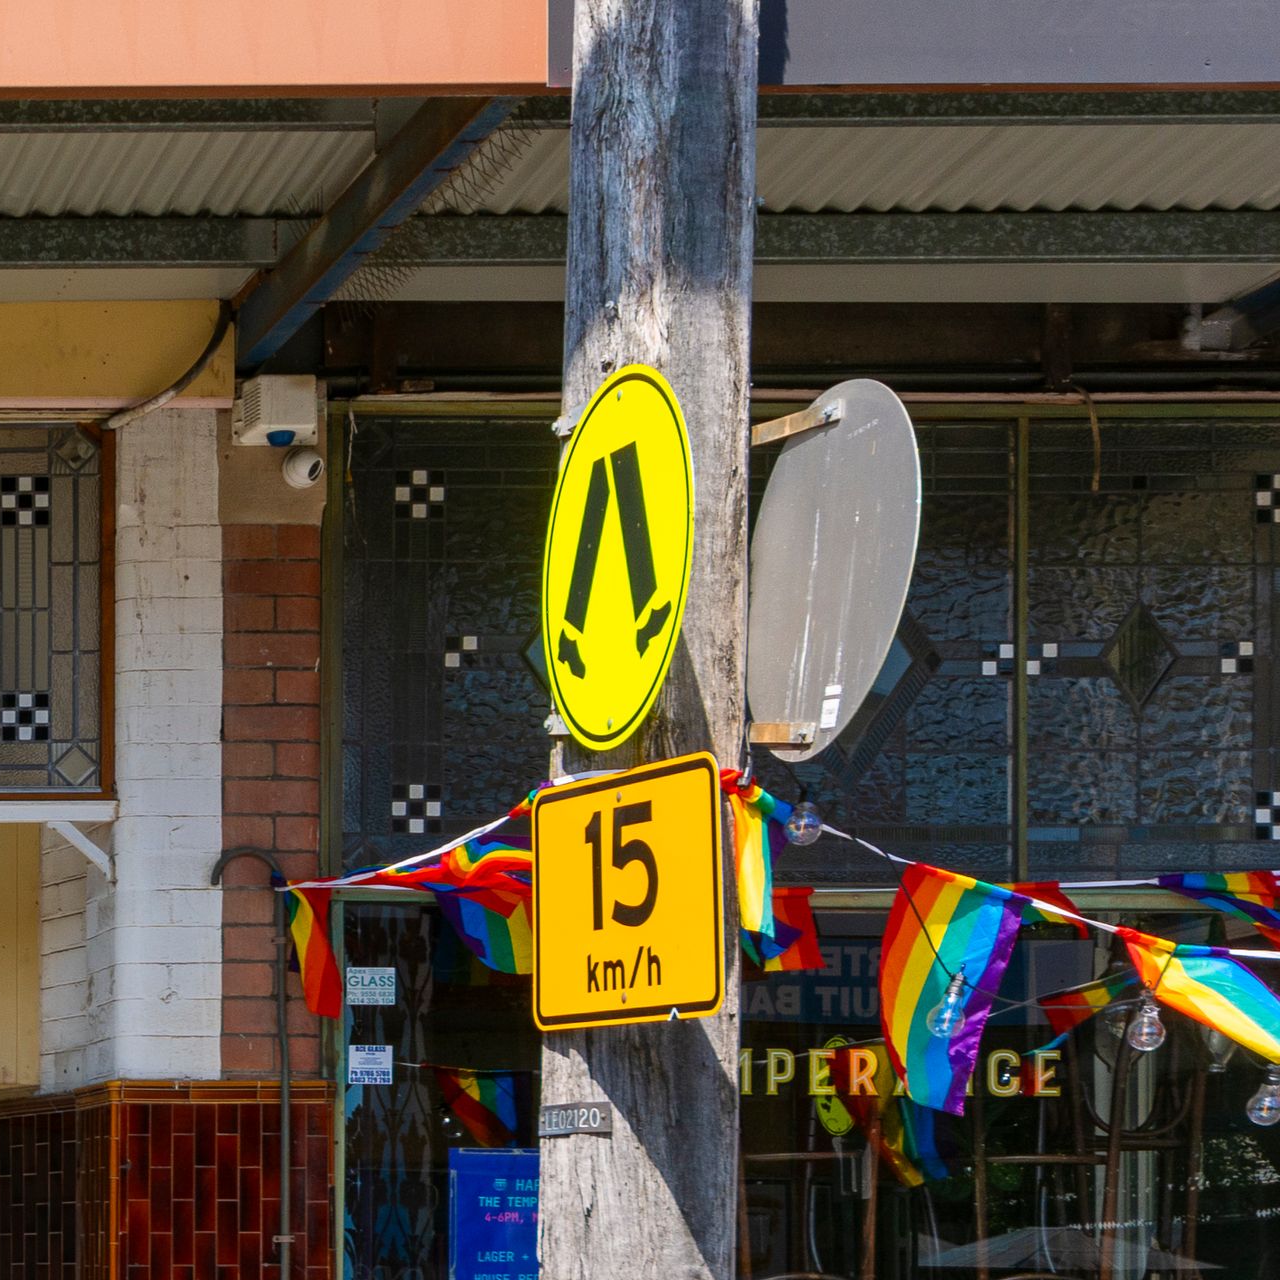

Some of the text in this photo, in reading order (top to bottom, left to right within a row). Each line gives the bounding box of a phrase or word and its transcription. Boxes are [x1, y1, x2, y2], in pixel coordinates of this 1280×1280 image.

[585, 800, 659, 931] 15
[587, 946, 662, 993] km/h
[348, 975, 394, 987] GLASS
[478, 1196, 538, 1208] THE TEMP
[477, 1251, 515, 1262] LAGER
